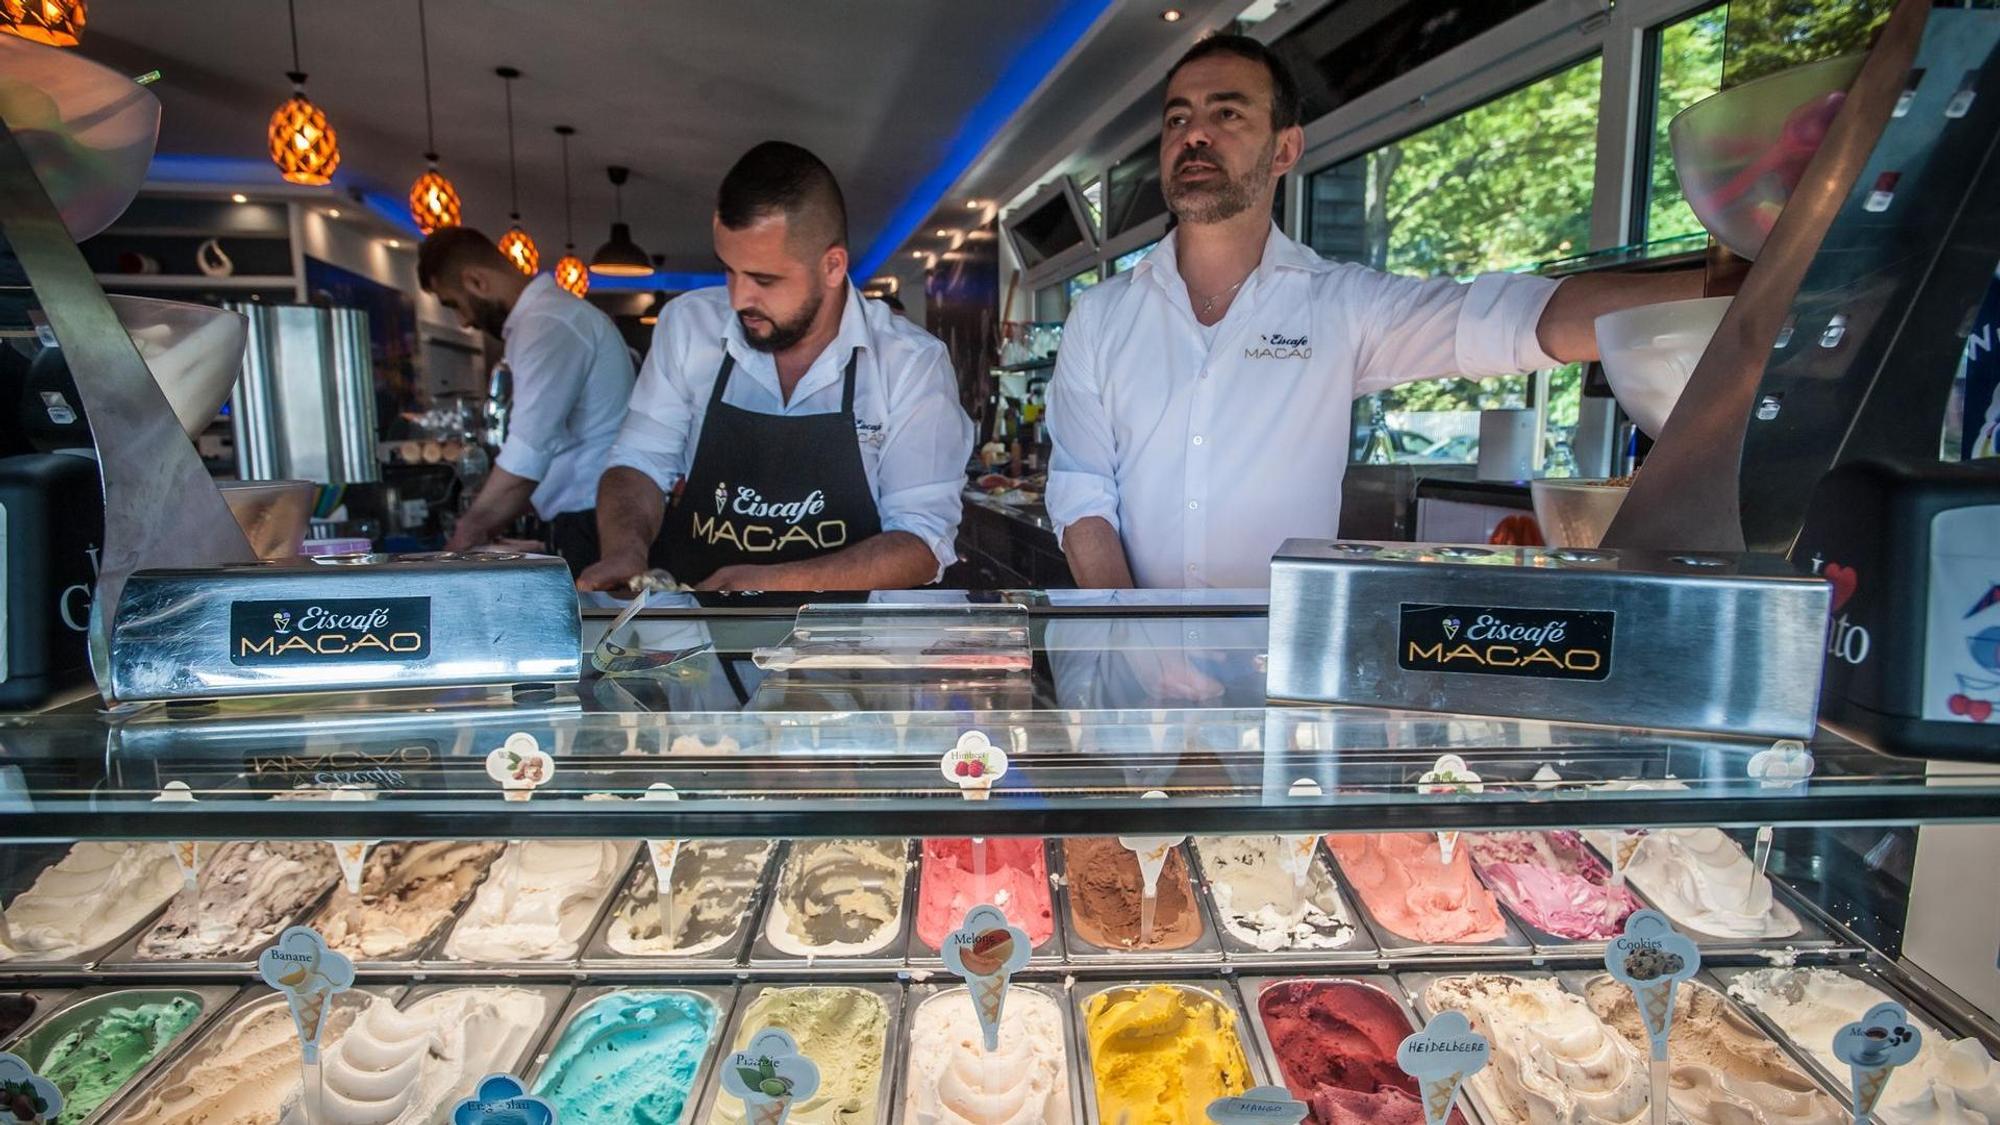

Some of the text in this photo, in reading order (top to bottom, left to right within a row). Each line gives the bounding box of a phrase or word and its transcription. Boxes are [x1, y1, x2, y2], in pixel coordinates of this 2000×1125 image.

[1244, 347, 1312, 360] MACAO
[733, 486, 825, 524] Eiscafé
[692, 512, 846, 551] MACAO
[298, 606, 390, 633] Eiscafé
[1467, 614, 1568, 646] Eiscafé
[241, 632, 422, 657] MACAO
[1408, 641, 1601, 671] MACAO
[954, 932, 995, 944] Melone
[1617, 937, 1662, 950] Cookies
[271, 949, 312, 962] Banane
[1240, 1103, 1282, 1112] MANGO
